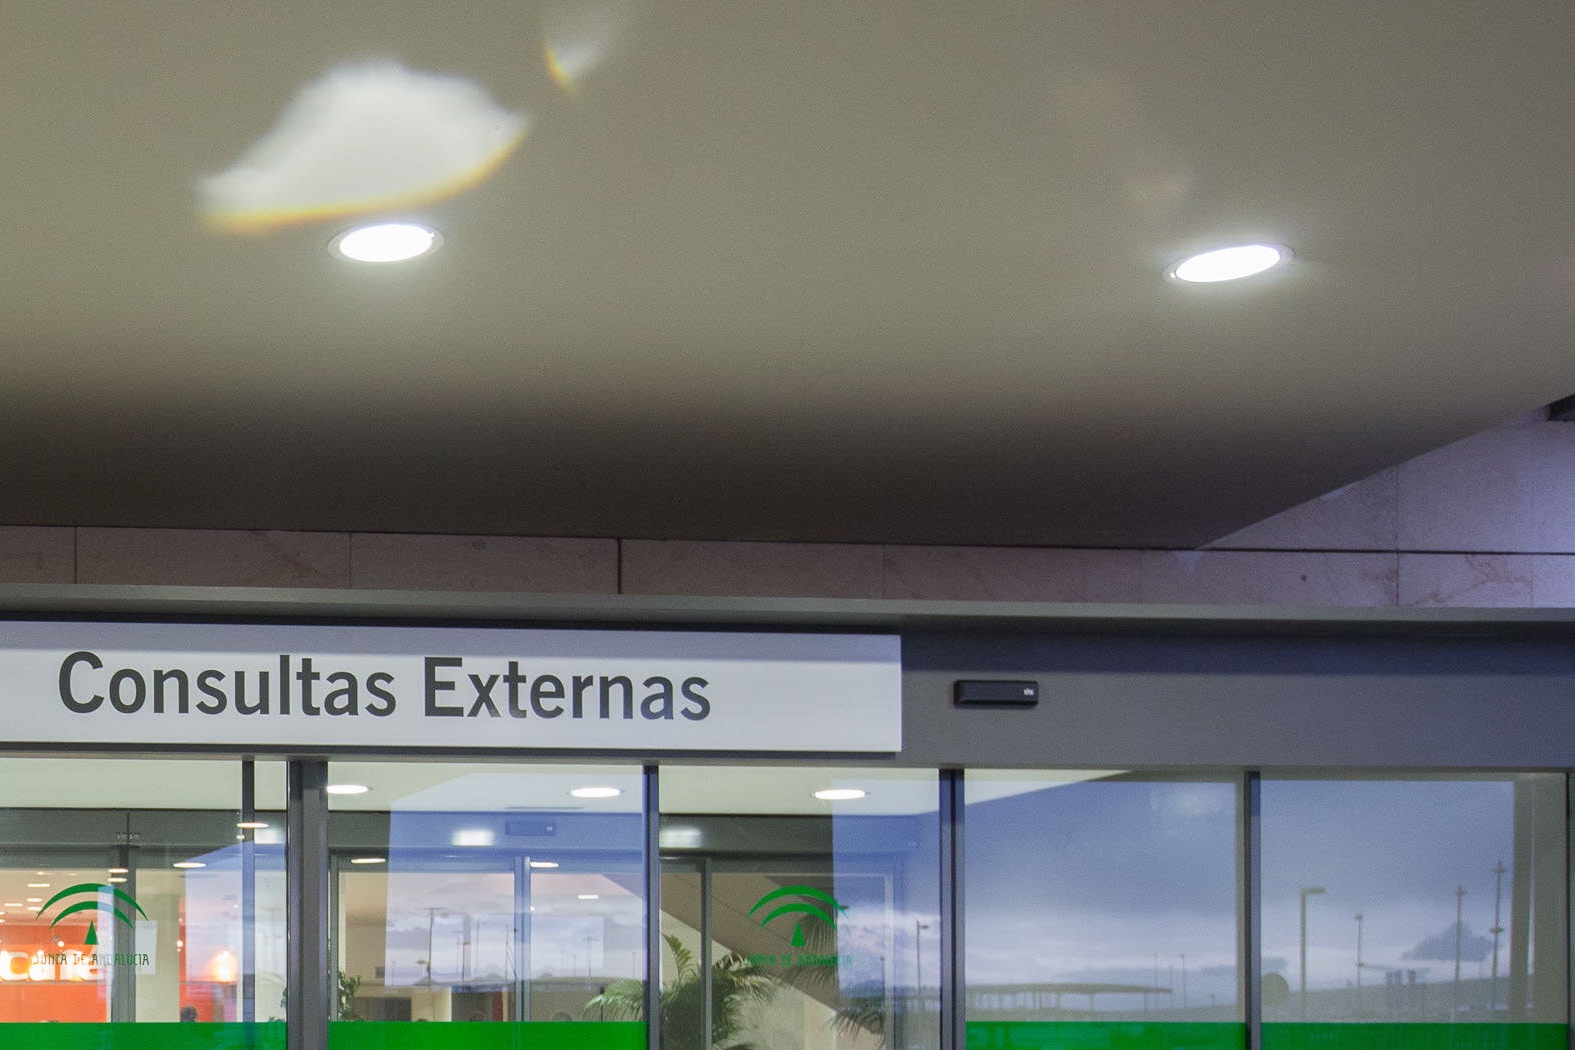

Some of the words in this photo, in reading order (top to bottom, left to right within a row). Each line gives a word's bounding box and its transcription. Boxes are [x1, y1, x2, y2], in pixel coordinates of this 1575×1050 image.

[58, 651, 397, 717] Consultas
[424, 656, 711, 721] Externas
[32, 953, 67, 966] JUNTA
[73, 953, 86, 965] DE
